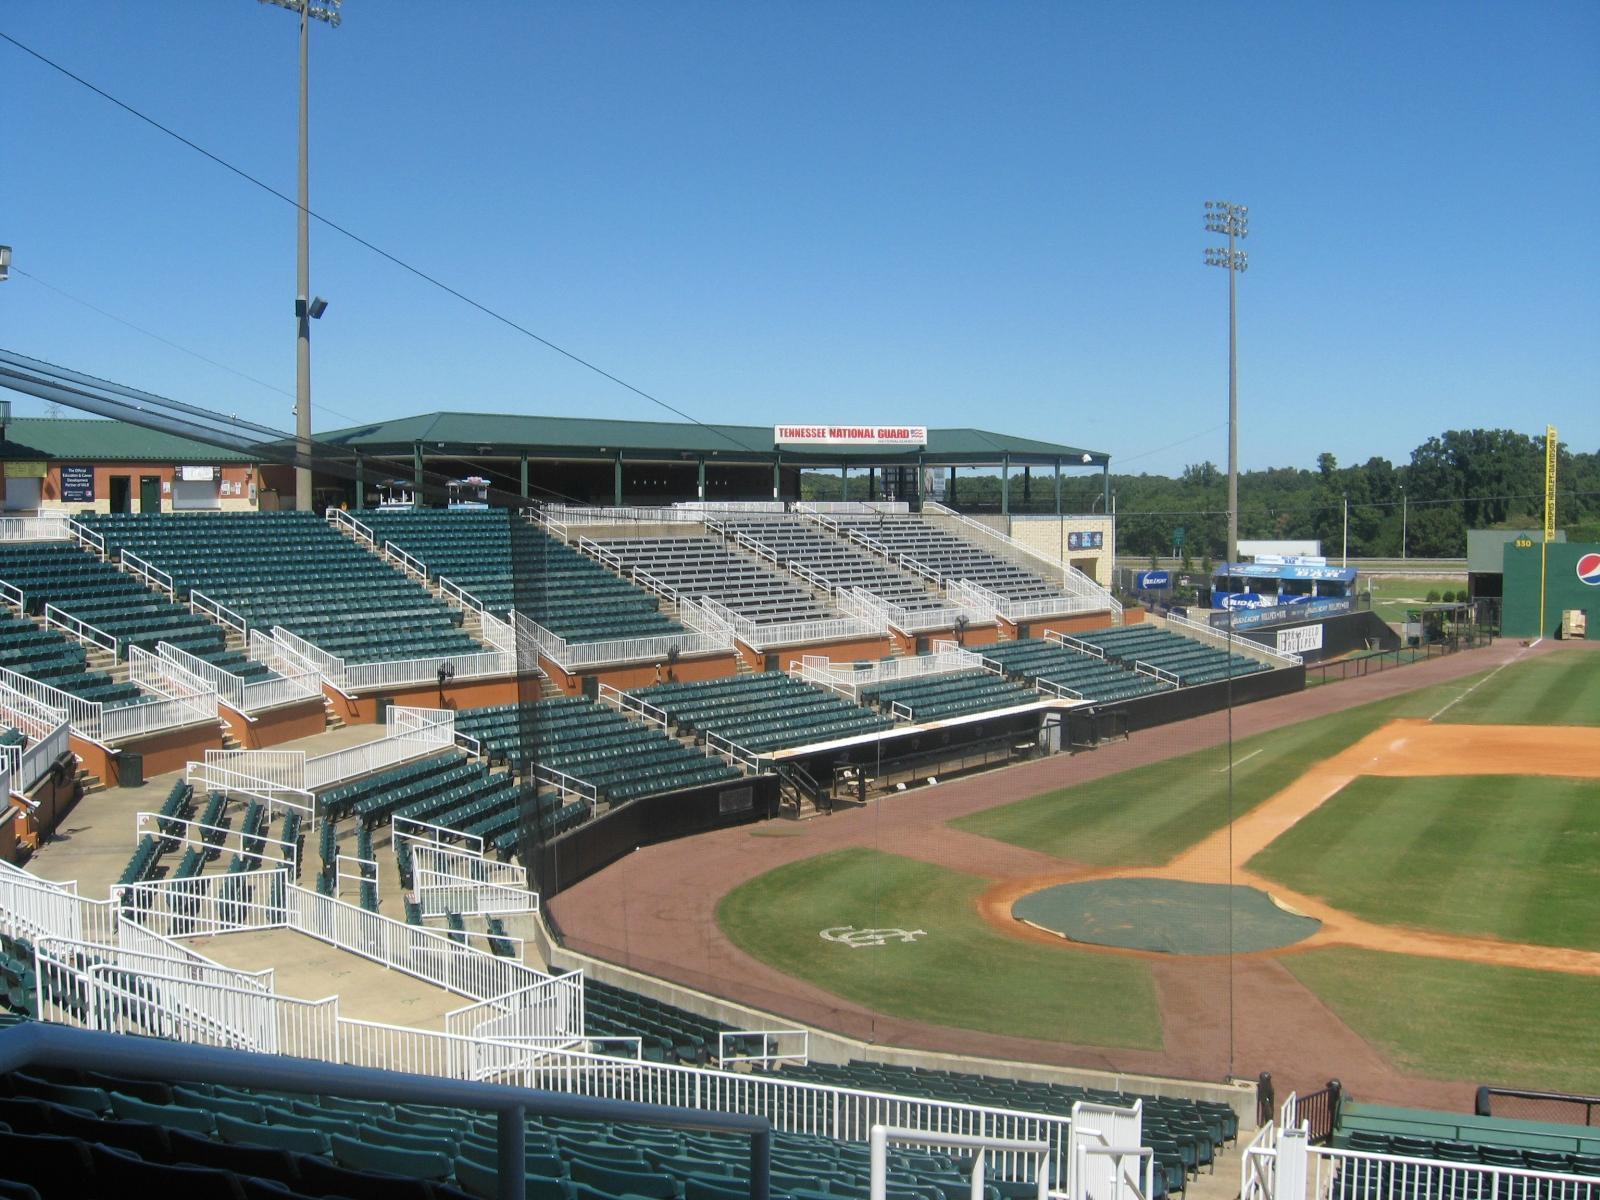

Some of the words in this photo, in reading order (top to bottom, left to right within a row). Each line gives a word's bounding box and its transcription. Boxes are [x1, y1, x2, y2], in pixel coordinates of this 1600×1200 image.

[779, 428, 826, 438] TENNESSEE
[829, 428, 875, 438] NATIONAL
[877, 428, 910, 438] GUARD
[1548, 439, 1556, 501] HARLEY-DAVIDSON
[1287, 637, 1316, 651] BULPEN
